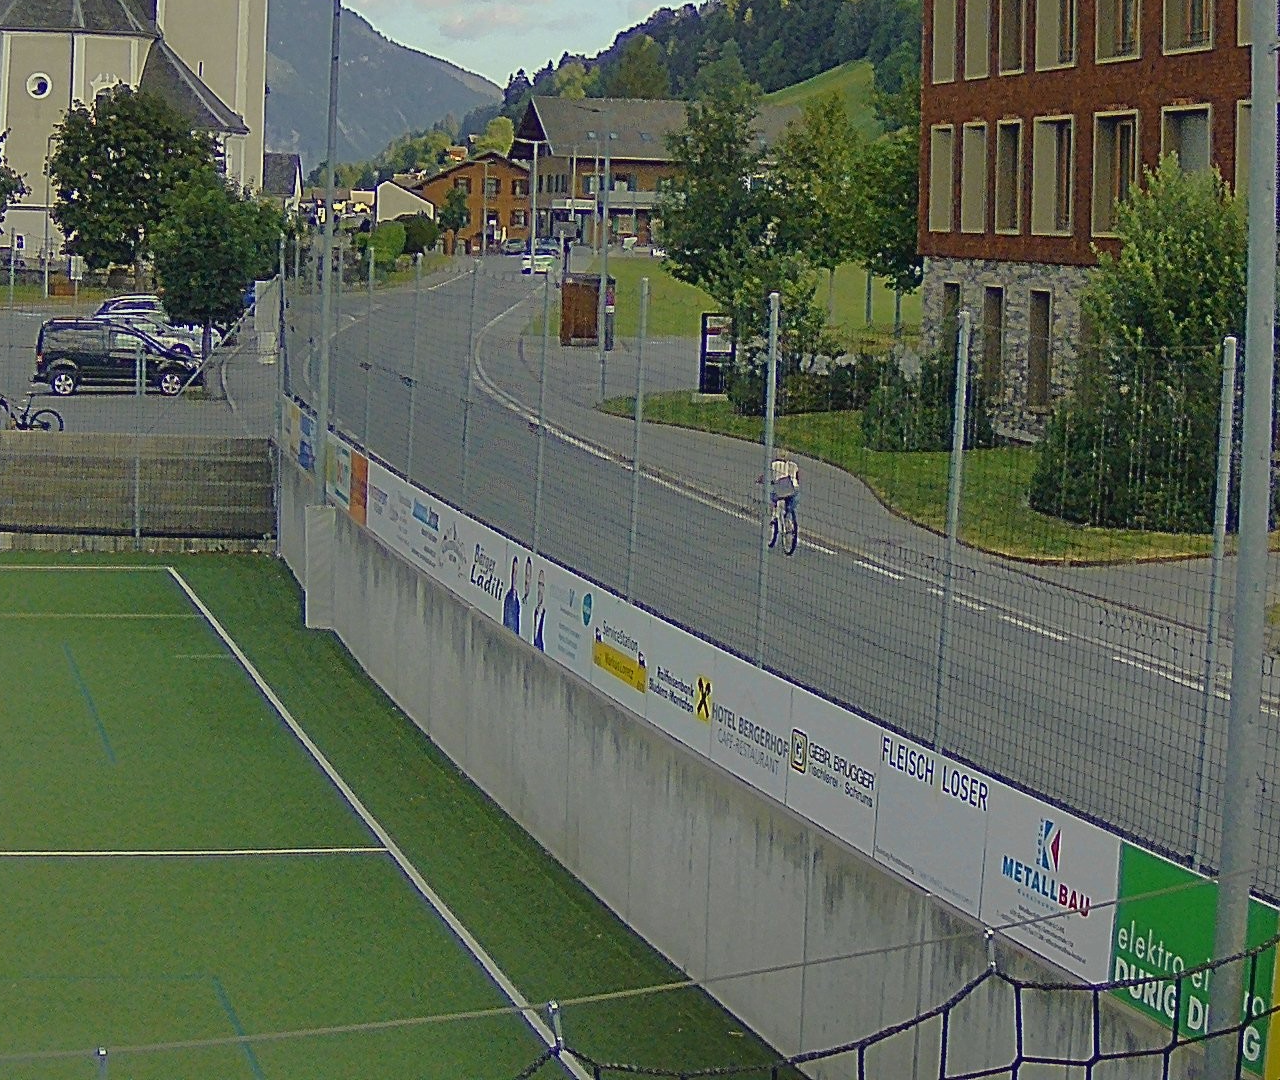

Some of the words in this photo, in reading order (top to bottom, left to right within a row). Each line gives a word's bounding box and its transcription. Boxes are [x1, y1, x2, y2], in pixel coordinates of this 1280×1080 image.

[712, 702, 736, 731] HOTEL
[739, 717, 789, 758] BERGERHOF
[845, 781, 873, 808] Schruns
[882, 736, 935, 785] FLEISCH
[942, 765, 989, 811] LOSER
[1002, 855, 1091, 917] METALLBAU
[1118, 920, 1184, 976] elektro
